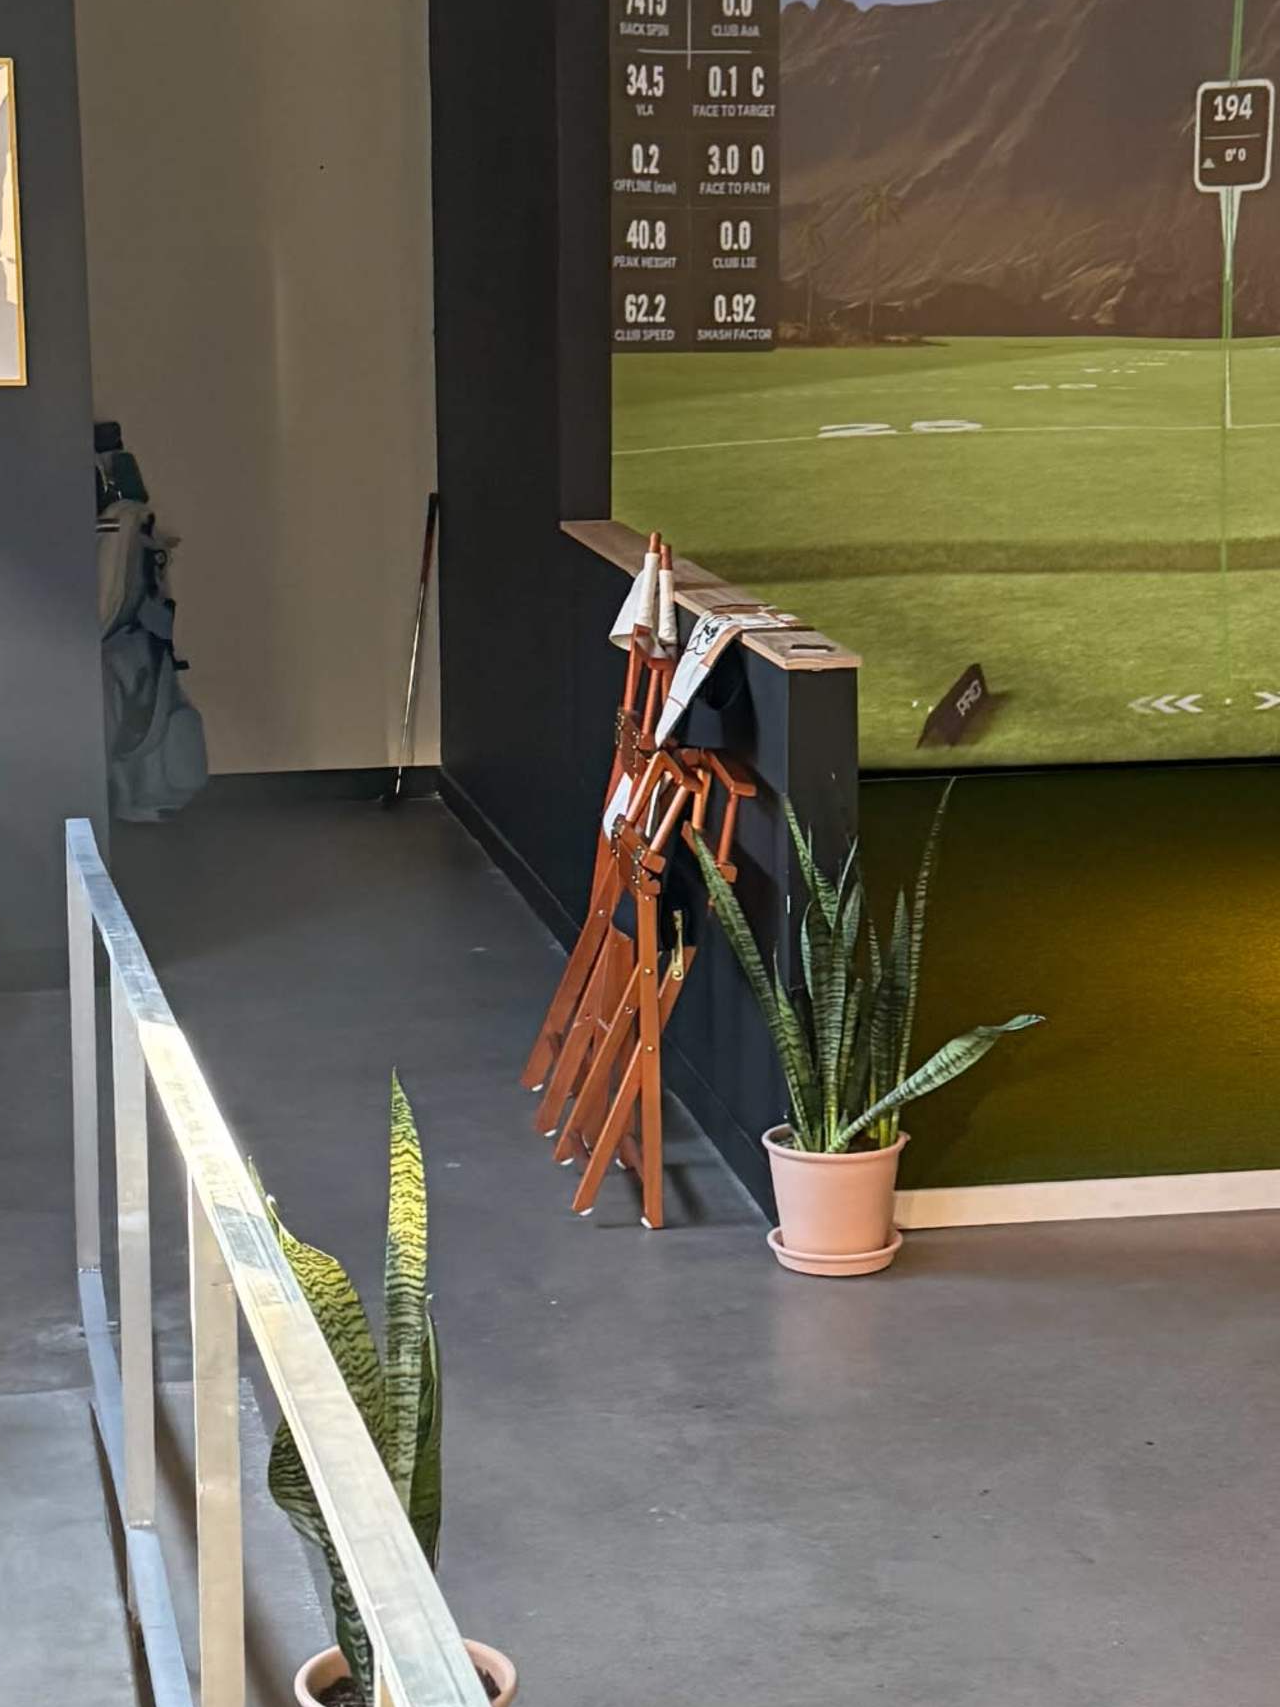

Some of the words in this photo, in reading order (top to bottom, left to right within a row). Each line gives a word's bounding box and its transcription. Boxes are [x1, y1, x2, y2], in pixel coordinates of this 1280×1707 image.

[626, 64, 664, 97] 34.5
[708, 66, 737, 97] 0.1
[752, 66, 765, 97] C
[692, 104, 719, 117] FACE
[721, 105, 736, 117] TO
[737, 105, 776, 117] TARGET
[1213, 93, 1253, 121] 194
[632, 143, 660, 174] 0.2
[707, 145, 740, 175] 3.0
[699, 181, 726, 195] FACE
[728, 182, 742, 195] TO
[744, 182, 770, 195] PATH
[626, 220, 666, 250] 40.8
[720, 221, 751, 251] 0.0
[624, 294, 666, 323] 62.2
[714, 294, 756, 323] 0.92
[642, 329, 675, 342] SPEED
[696, 329, 733, 341] SMASH
[733, 329, 772, 341] FACTOR
